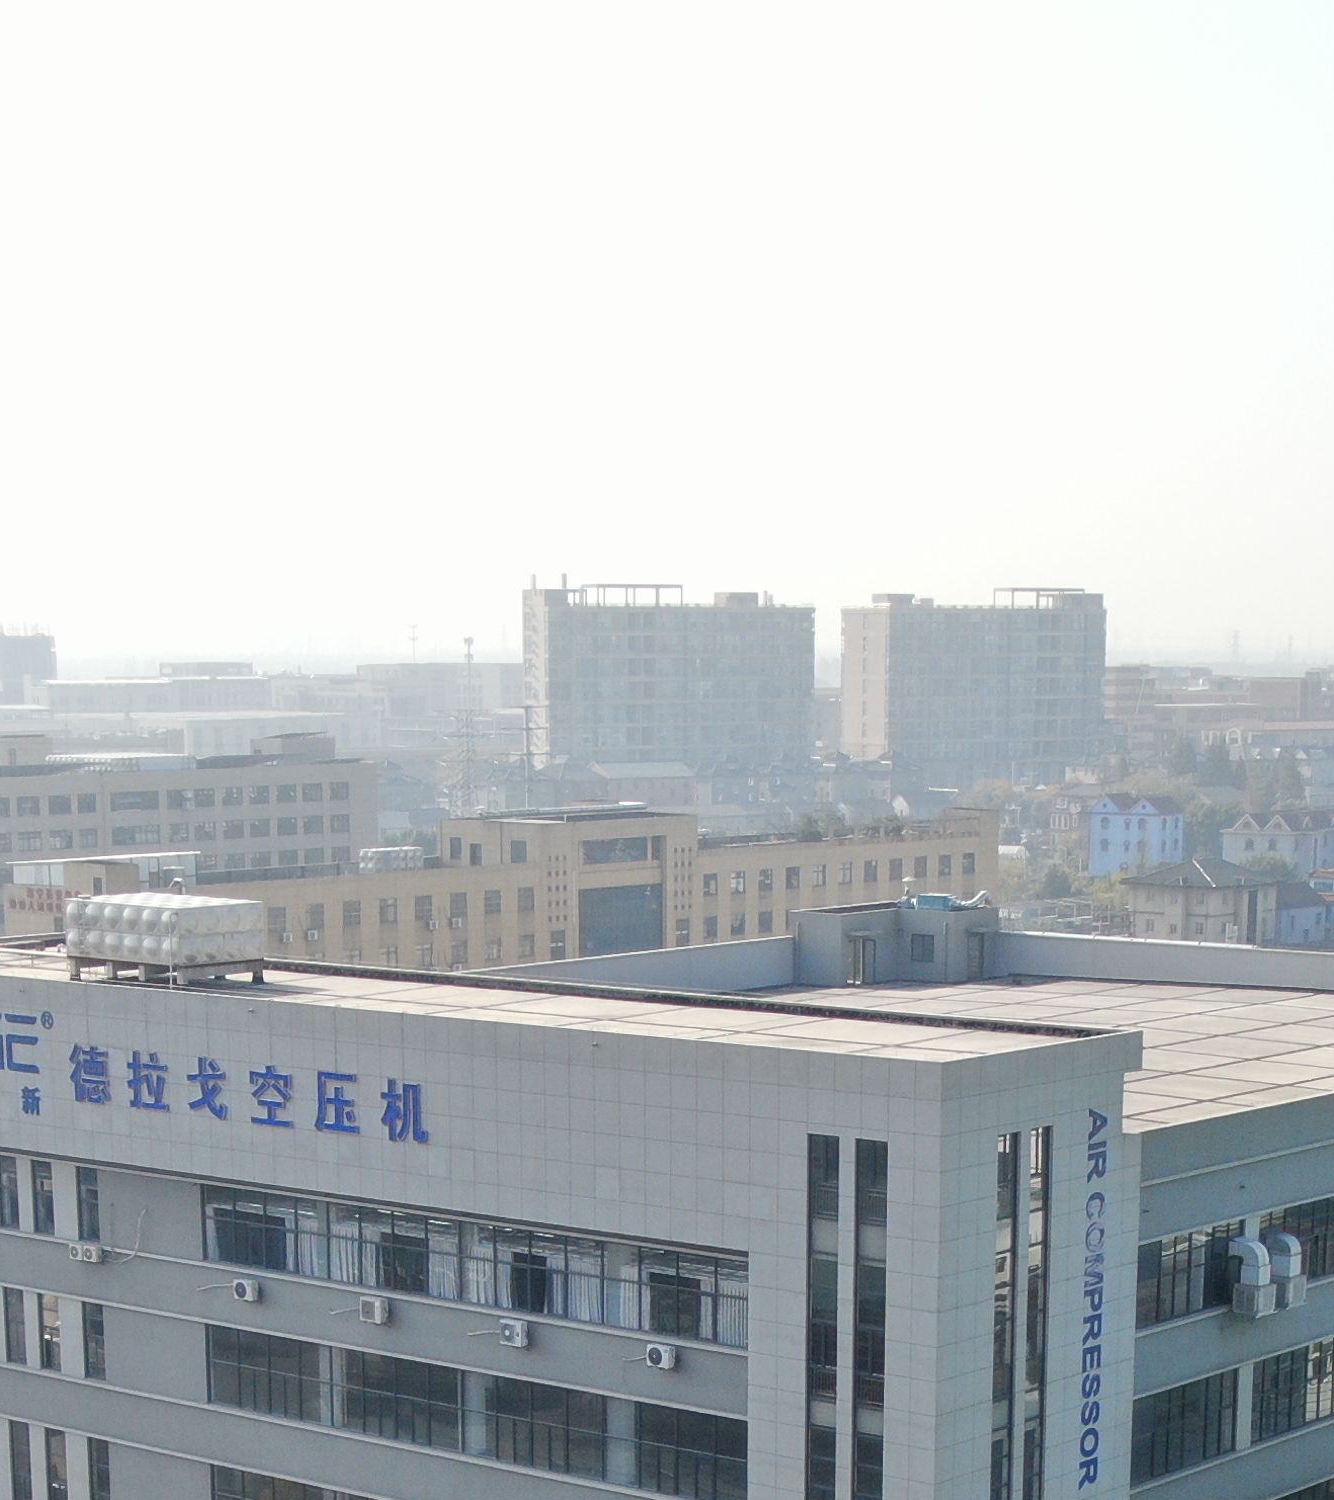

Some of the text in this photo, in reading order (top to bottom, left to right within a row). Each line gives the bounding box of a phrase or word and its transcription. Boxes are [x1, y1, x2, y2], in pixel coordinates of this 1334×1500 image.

[69, 1043, 430, 1145] 德拉戈空压机
[1077, 1109, 1109, 1491] AIR COMPRESSOR
